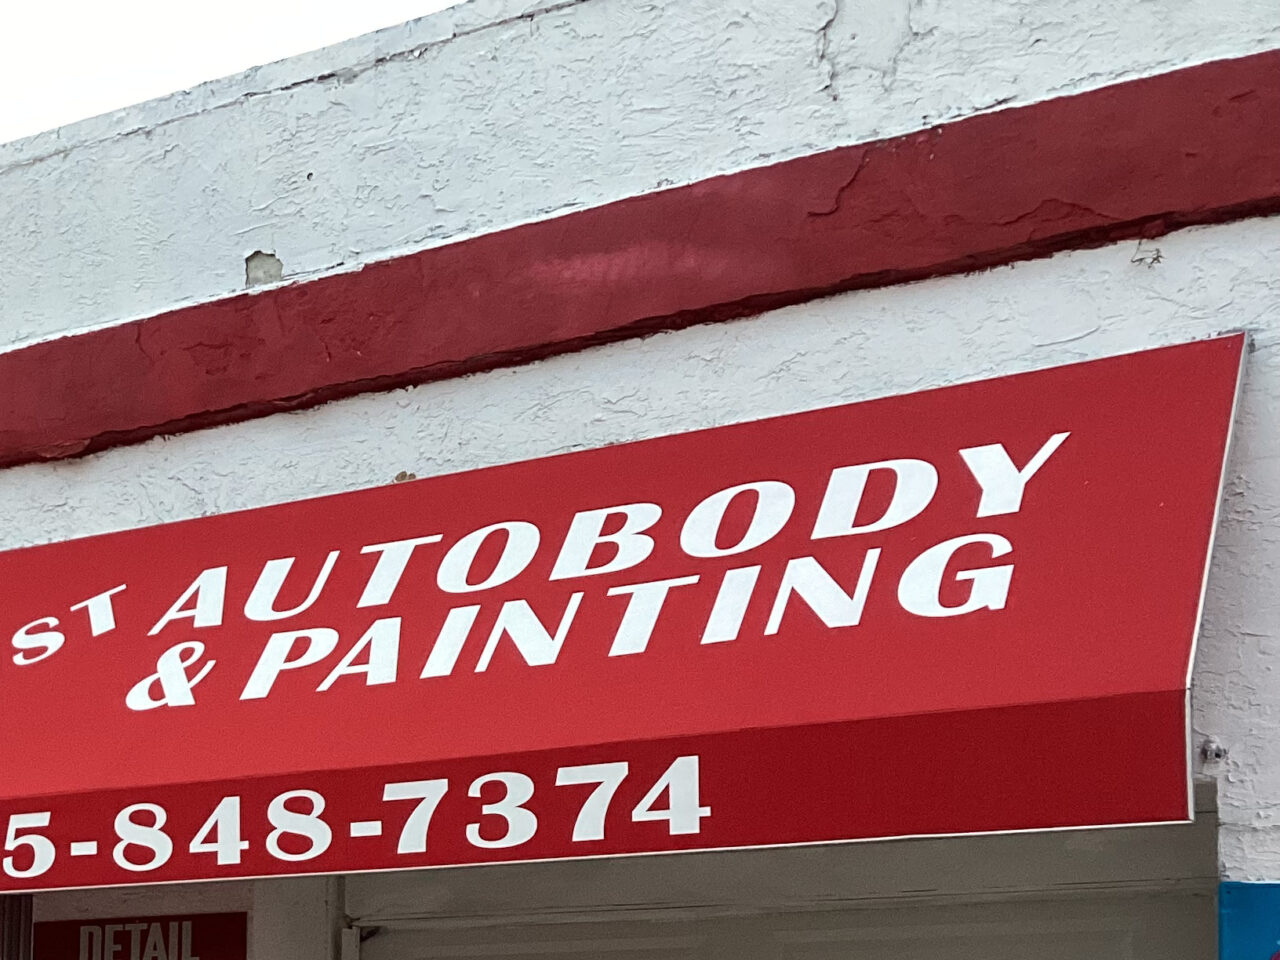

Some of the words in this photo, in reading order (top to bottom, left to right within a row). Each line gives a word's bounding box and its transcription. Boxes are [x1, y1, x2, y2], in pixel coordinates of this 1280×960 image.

[124, 640, 217, 712] &
[239, 533, 1015, 702] PAINTING
[147, 431, 1071, 637] AUTOBODY
